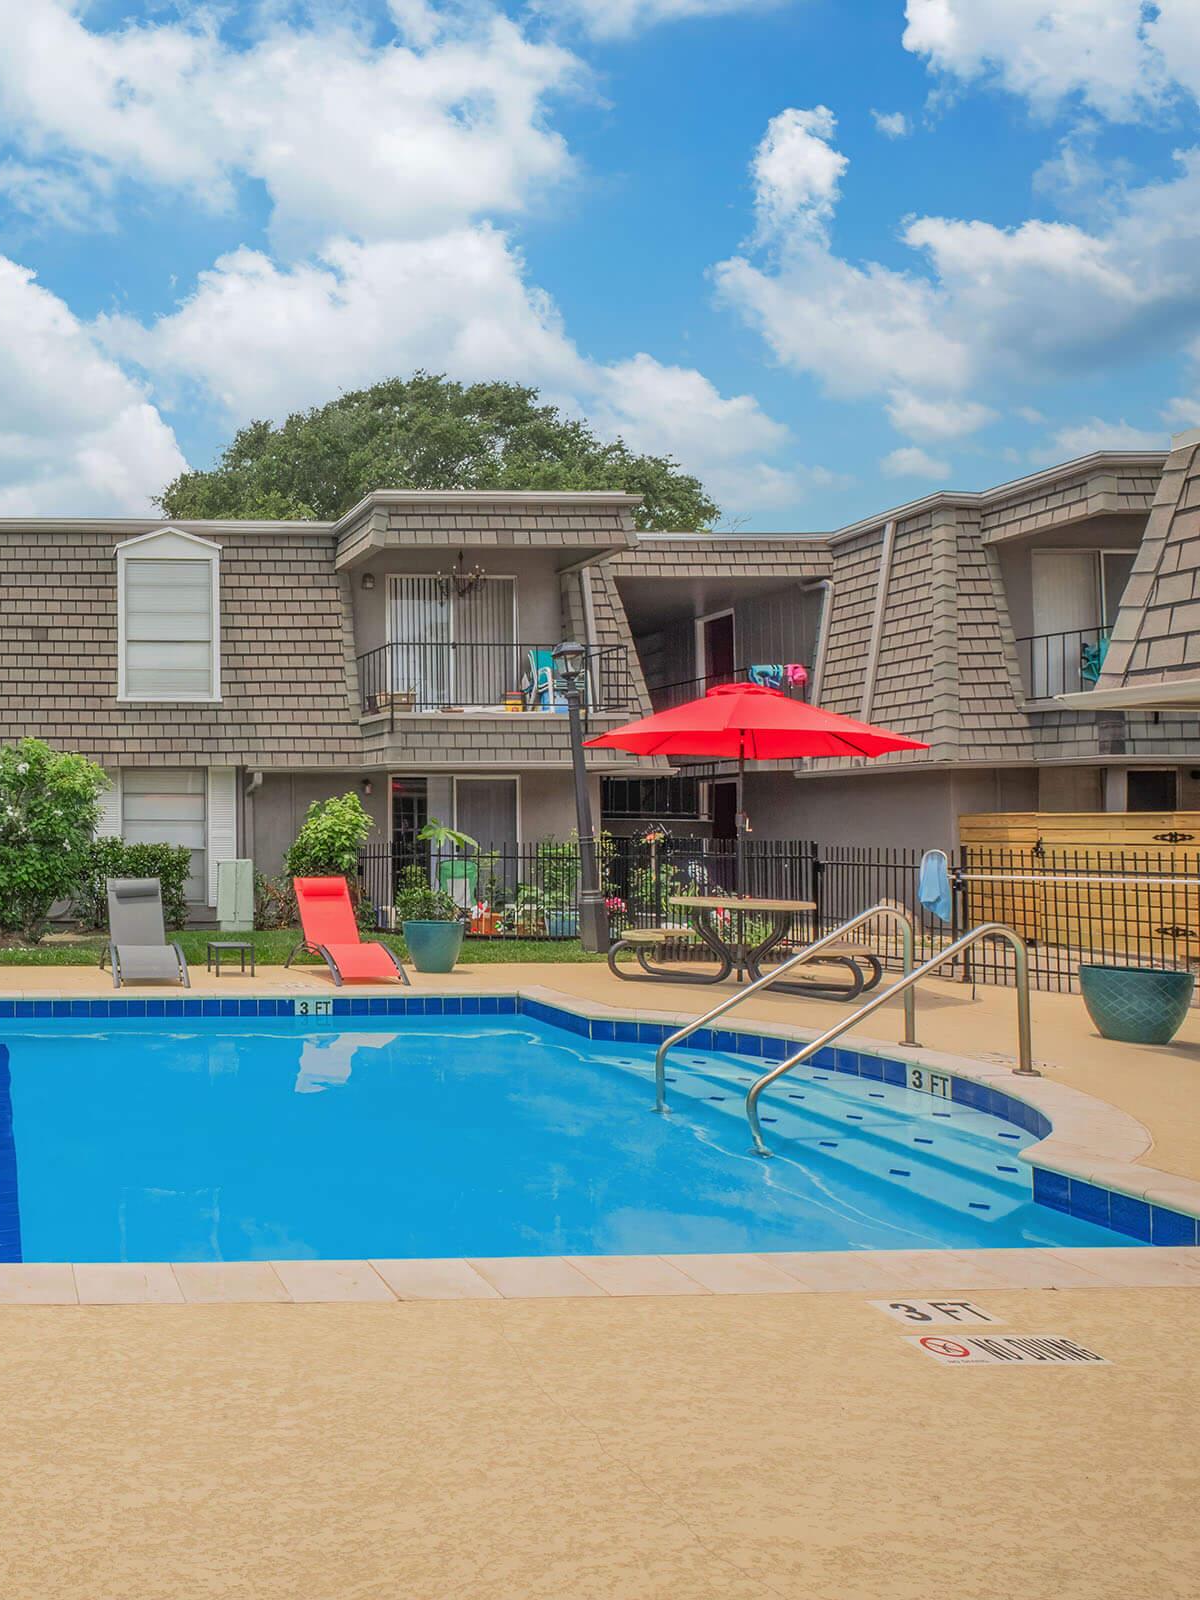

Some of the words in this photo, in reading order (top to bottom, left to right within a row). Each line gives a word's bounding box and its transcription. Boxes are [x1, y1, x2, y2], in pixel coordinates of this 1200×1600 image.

[300, 1001, 309, 1015] 3
[315, 1001, 331, 1015] FT
[911, 1069, 923, 1089] 3
[930, 1074, 949, 1097] FT
[889, 1303, 933, 1322] 3
[926, 1302, 992, 1322] FT
[966, 1338, 1023, 1361] NO
[1003, 1338, 1104, 1361] DIVING
